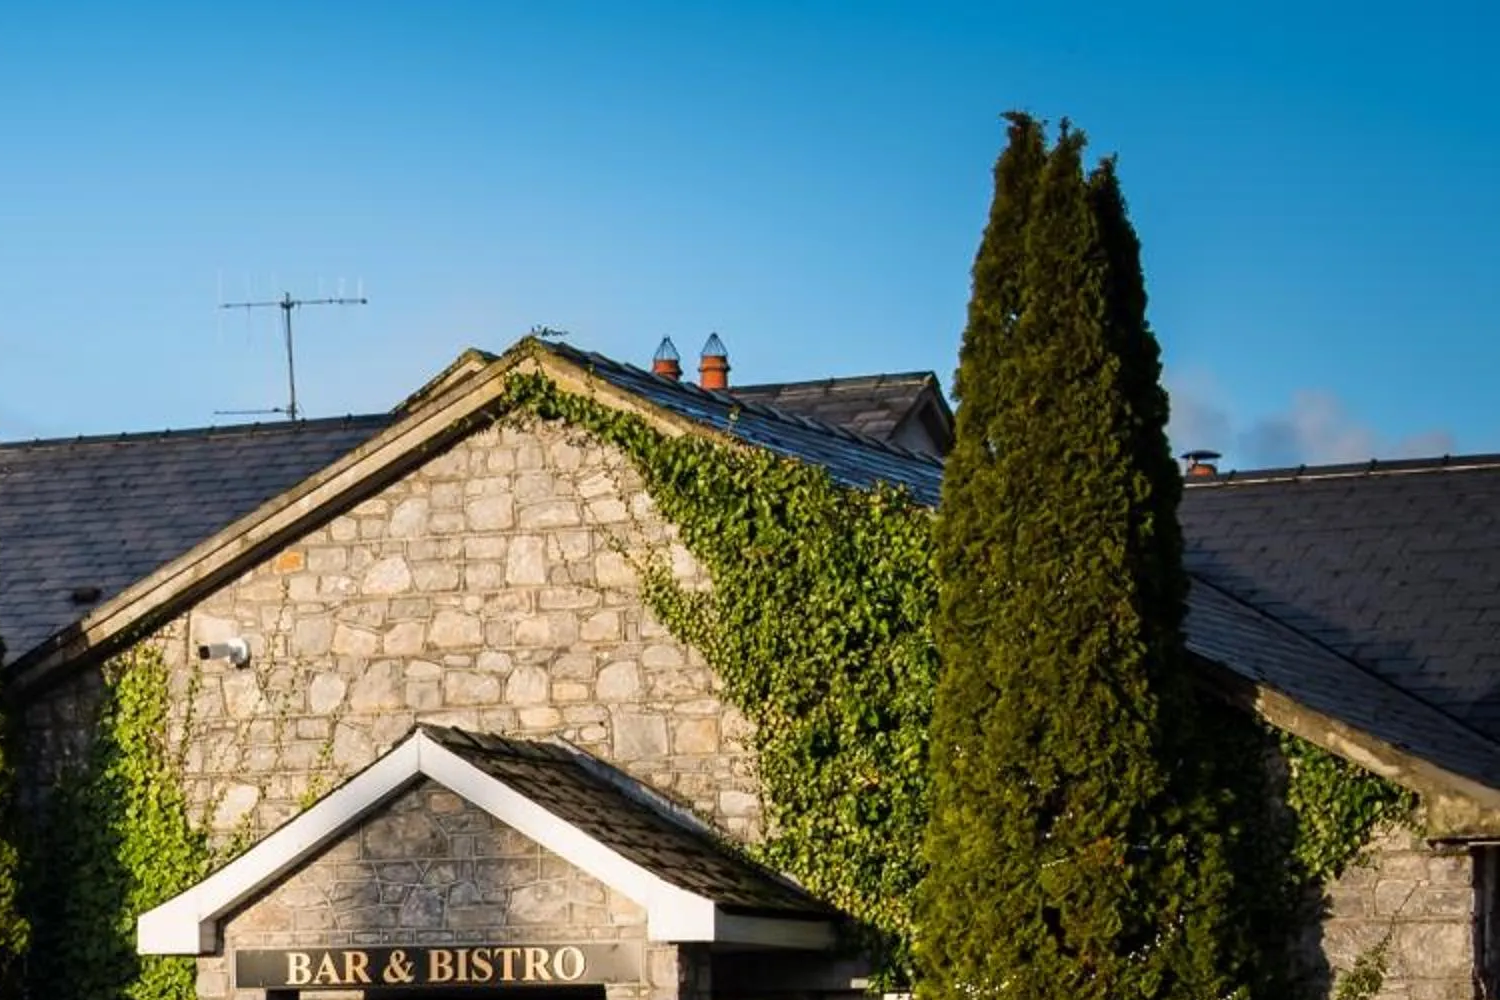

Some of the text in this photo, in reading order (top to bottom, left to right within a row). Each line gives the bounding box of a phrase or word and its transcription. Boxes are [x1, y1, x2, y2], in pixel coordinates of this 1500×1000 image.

[285, 945, 587, 986] BAR & BISTRO
